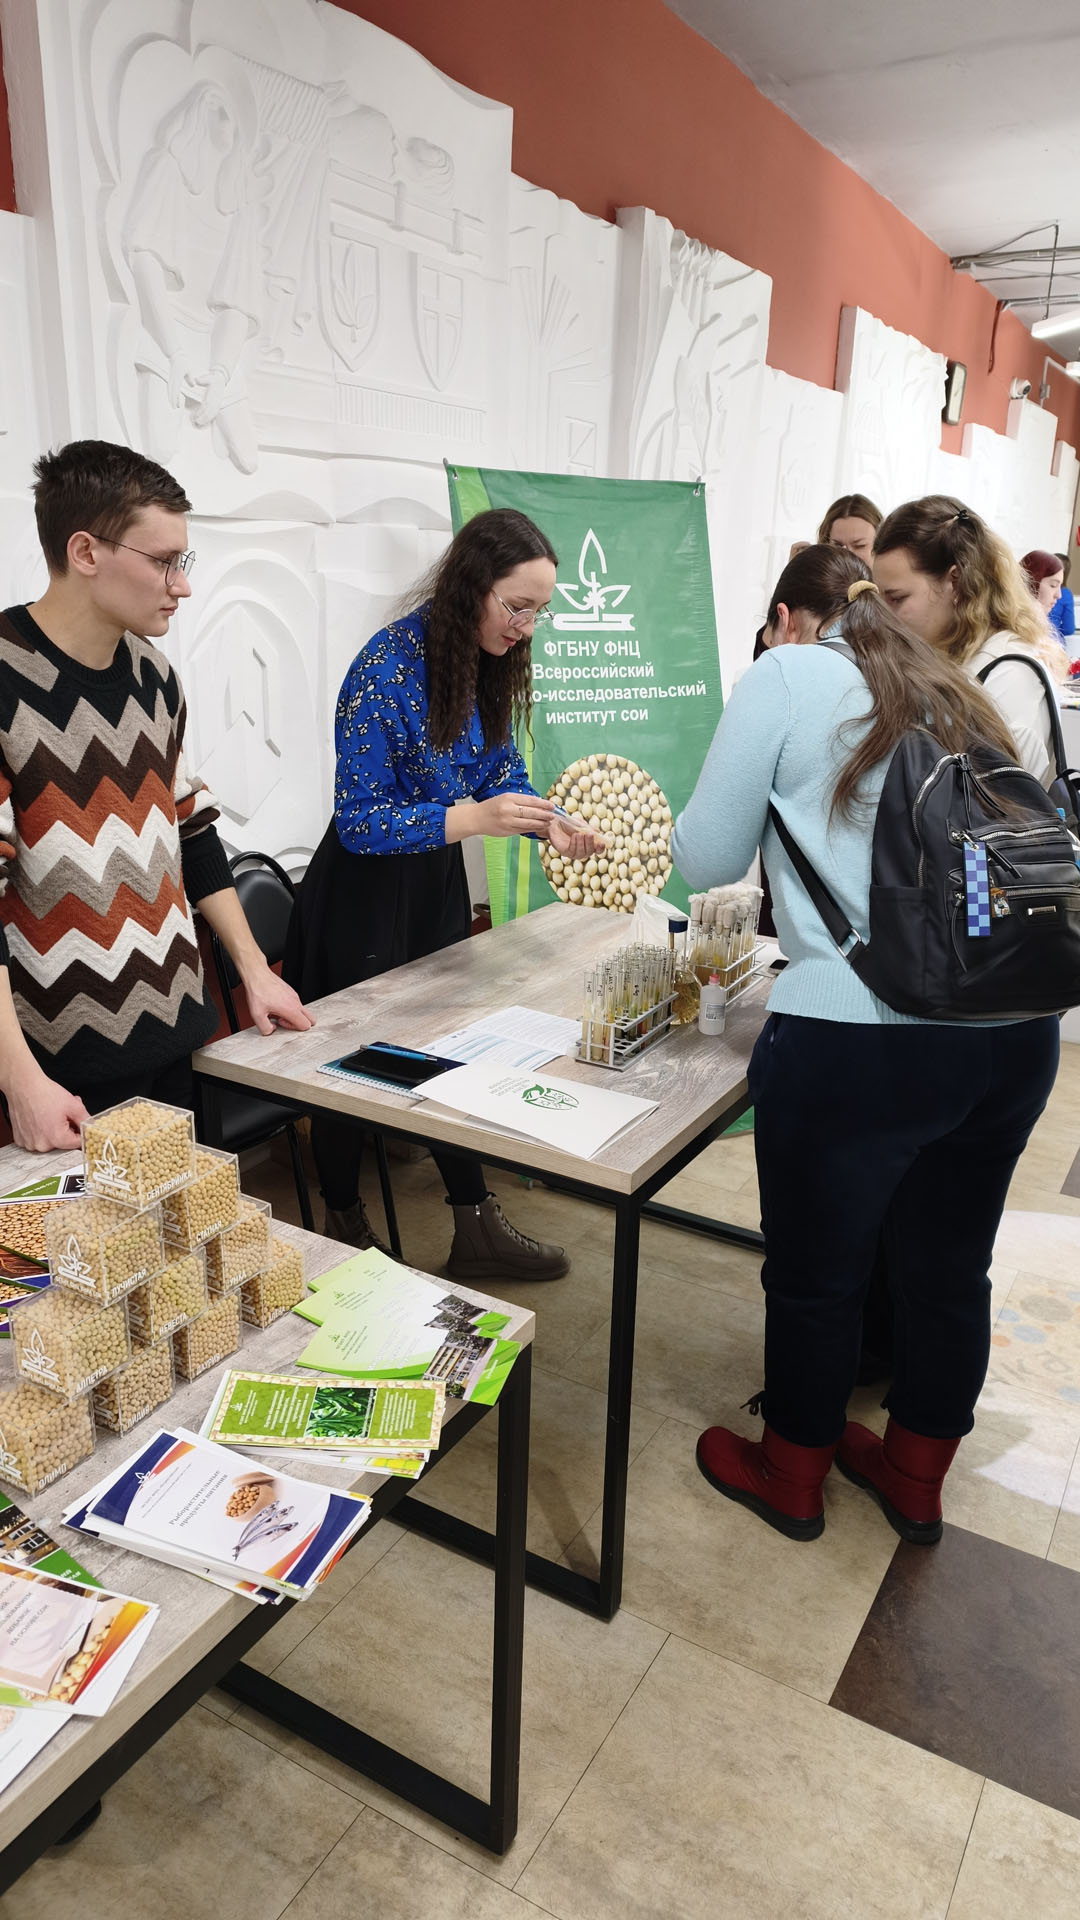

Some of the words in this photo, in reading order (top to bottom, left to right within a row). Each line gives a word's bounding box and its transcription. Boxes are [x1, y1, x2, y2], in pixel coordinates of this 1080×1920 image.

[544, 640, 599, 657] ФГБНУ
[604, 640, 641, 659] ФНЦ
[532, 661, 654, 683] Всероссийский
[529, 680, 707, 703] о-исследовательский
[545, 709, 617, 726] институт
[620, 708, 649, 721] сои
[146, 1169, 193, 1200] СЕНТЯБРИНКА
[196, 1220, 222, 1242] СТАТНАЯ
[111, 1268, 147, 1298] ЛУЧИСТАЯ
[159, 1312, 189, 1336] НЕВЕСТА
